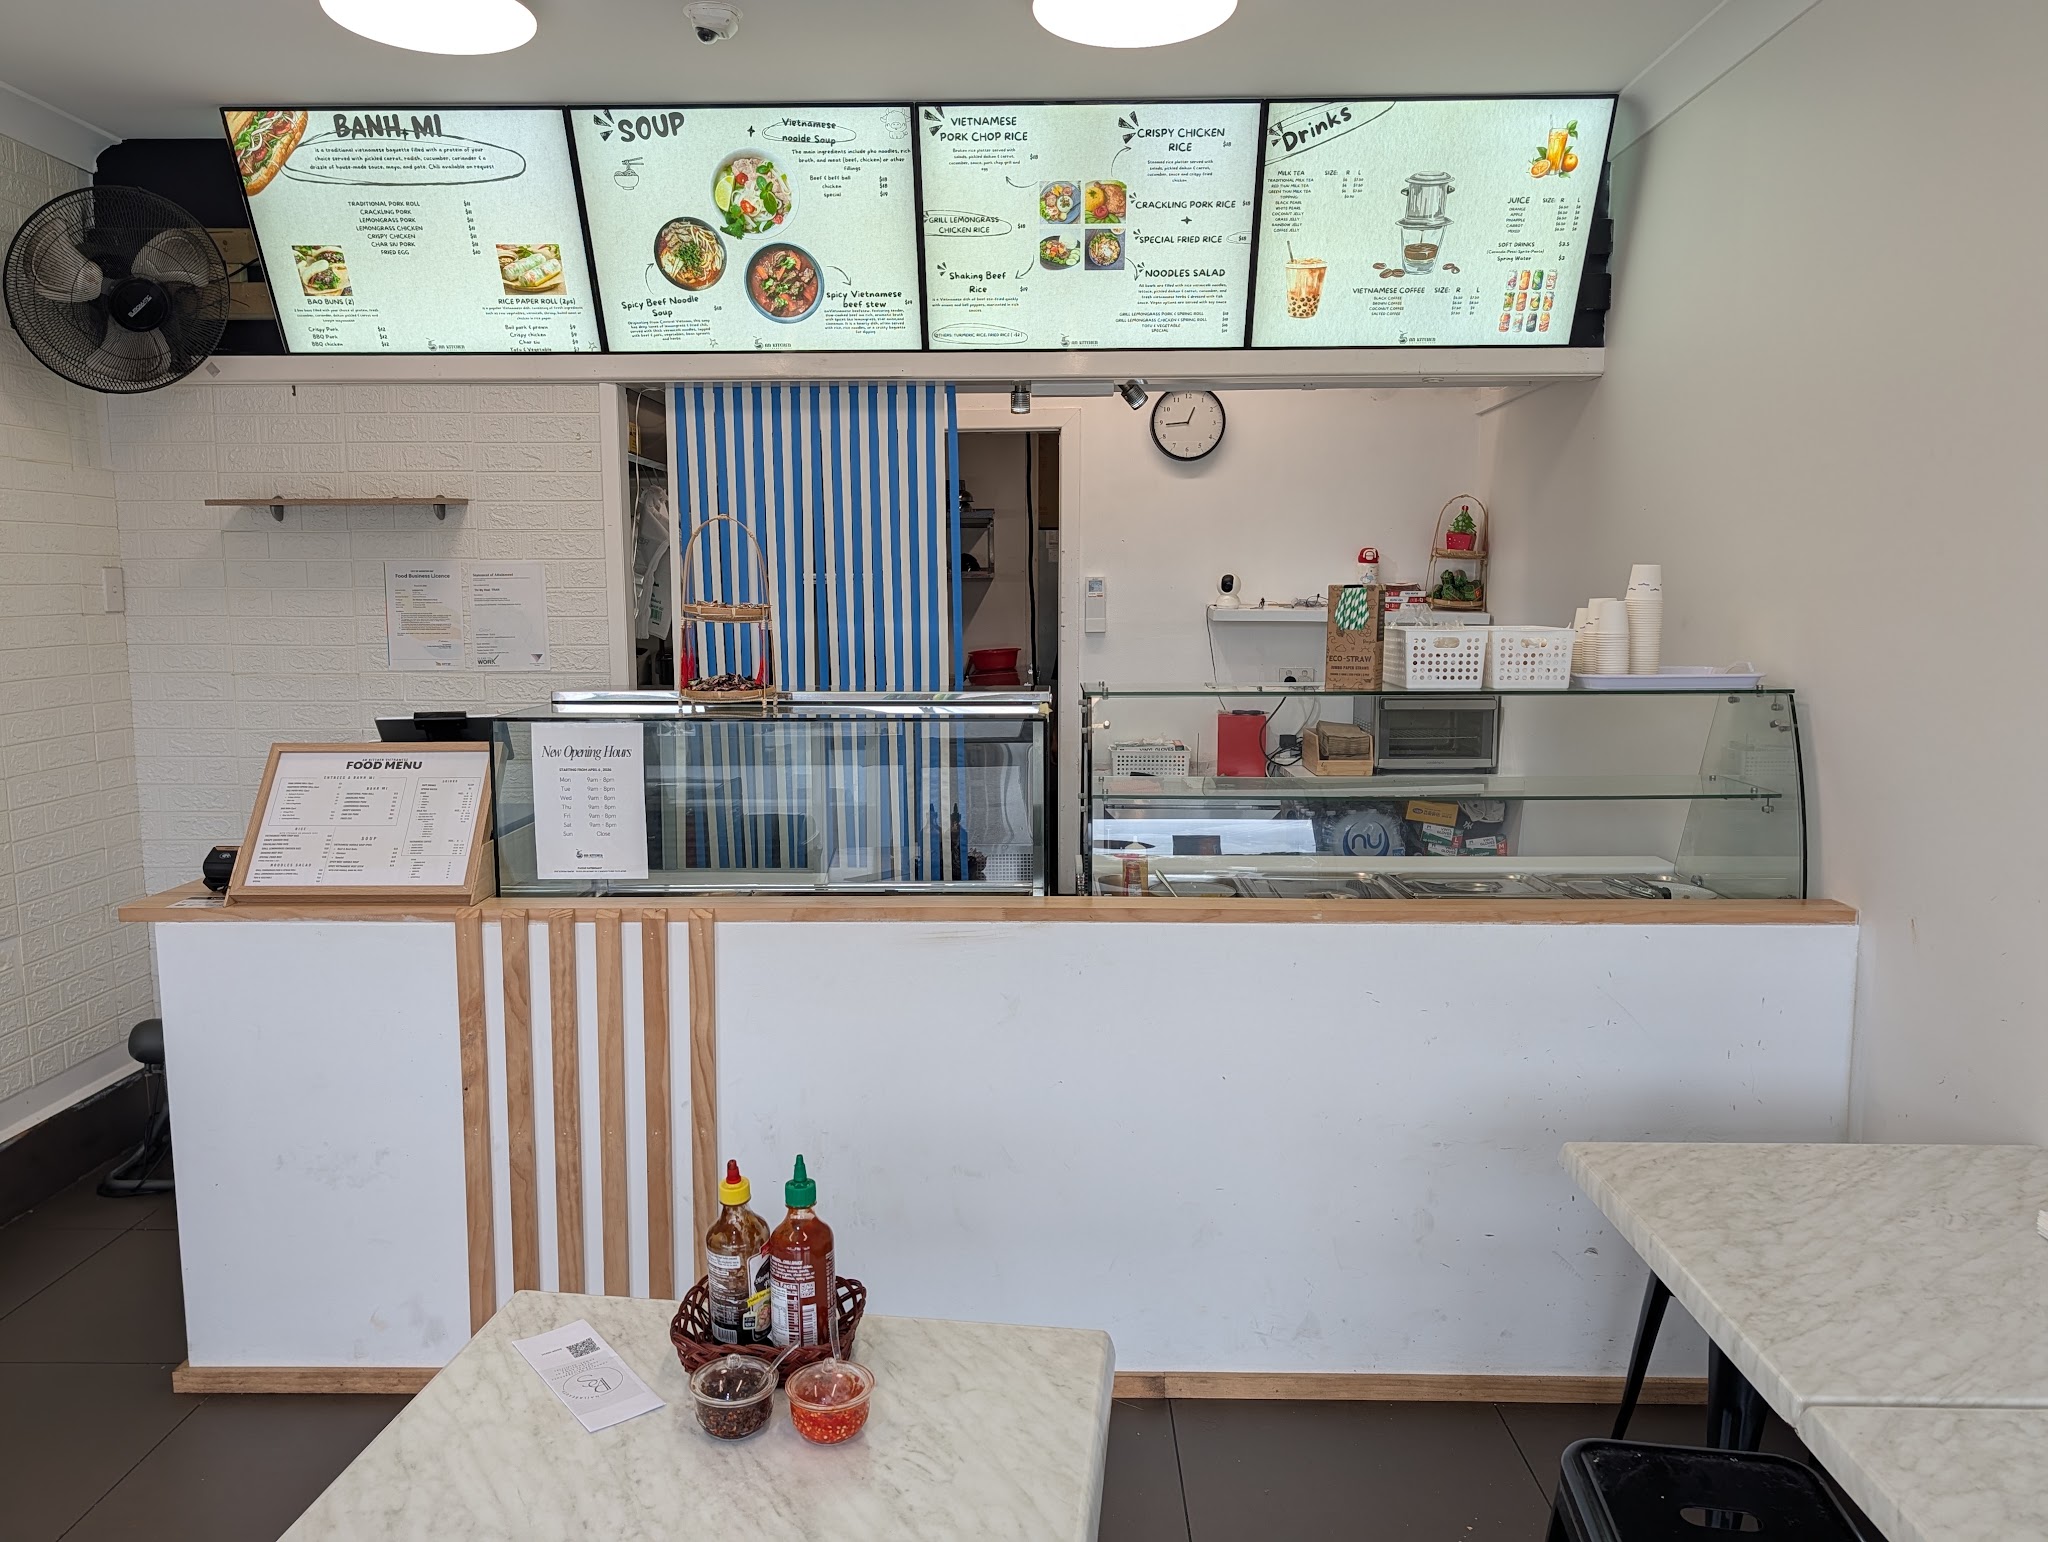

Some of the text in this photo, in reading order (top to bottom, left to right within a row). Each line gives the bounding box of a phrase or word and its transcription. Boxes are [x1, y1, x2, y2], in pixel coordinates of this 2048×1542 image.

[782, 118, 836, 129] Vietnamese
[951, 116, 1016, 126] VIETNAMESE
[333, 114, 442, 139] BANH MI
[618, 112, 684, 142] SOUP
[1282, 107, 1352, 151] Drinks
[940, 132, 1028, 141] PORK CHOP RICE
[1137, 128, 1225, 138] CRISPY CHICKEN
[814, 135, 836, 146] Soup
[1169, 142, 1192, 152] RICE
[1135, 201, 1187, 209] CRACKLING
[1139, 235, 1174, 244] SPECIAL
[1202, 235, 1222, 243] RICE
[949, 271, 1006, 282] Shaking Beef
[1145, 269, 1190, 277] NOODLES
[827, 291, 848, 300] spicy
[621, 296, 698, 311] Spicy Beef Noodle
[843, 299, 862, 308] beef
[652, 308, 673, 317] Soup
[542, 745, 632, 760] New Opening Hours
[346, 761, 422, 769] FOOD MENU
[1352, 833, 1382, 849] nu
